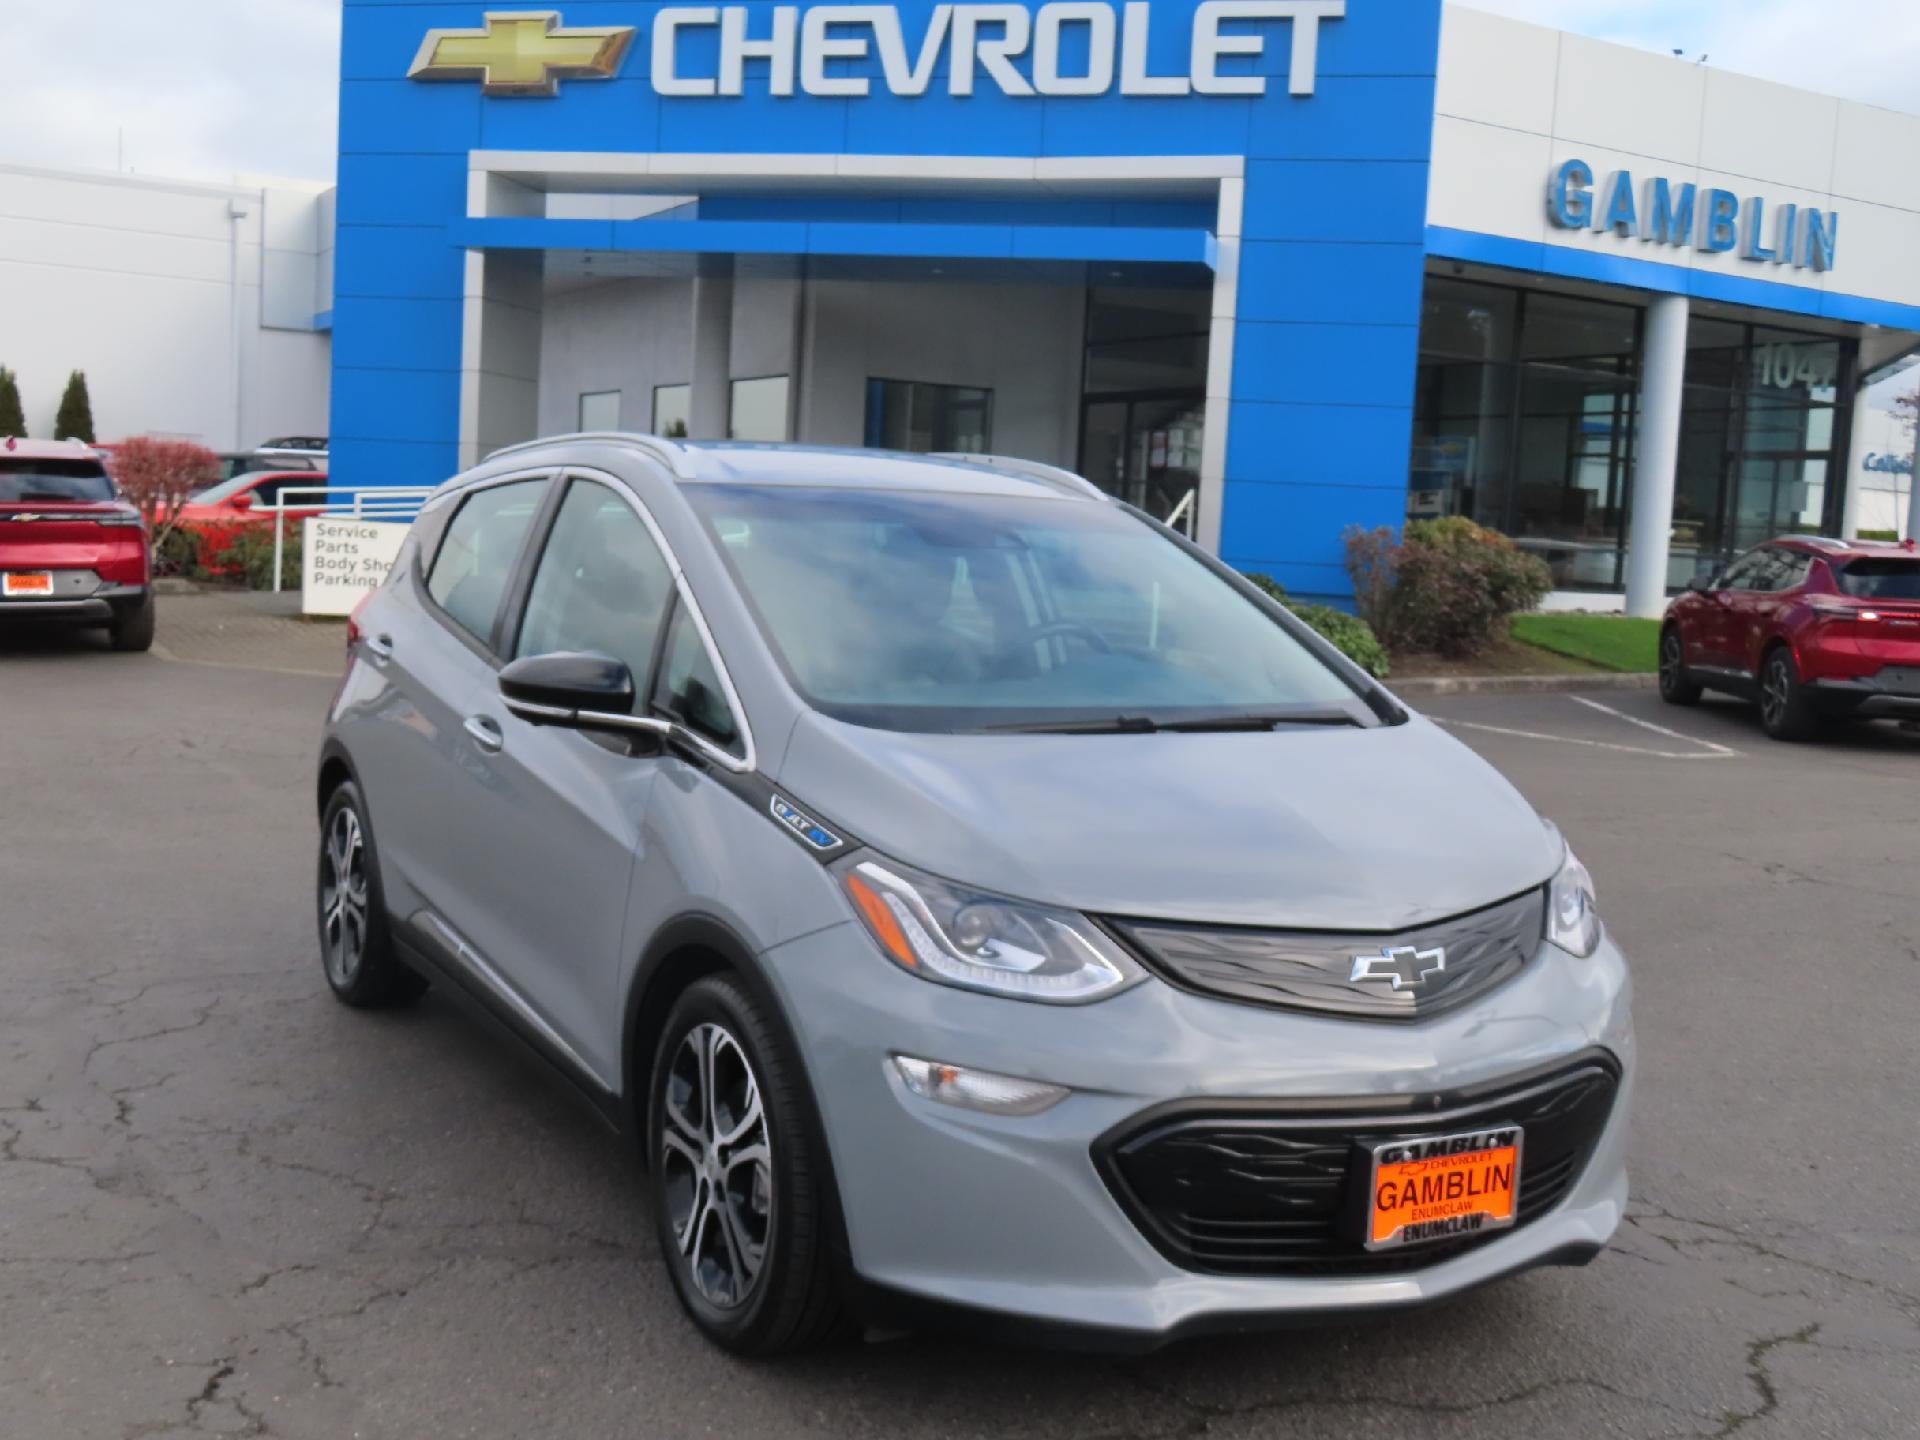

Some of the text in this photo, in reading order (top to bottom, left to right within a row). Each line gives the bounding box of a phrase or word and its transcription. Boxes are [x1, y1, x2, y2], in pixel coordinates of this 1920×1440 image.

[650, 0, 1346, 97] CHEVROLET
[1546, 158, 1839, 272] GAMBLIN
[316, 523, 378, 538] Service
[315, 539, 359, 553] Parts
[314, 556, 394, 573] Body Sho
[314, 571, 378, 590] Parking
[1430, 1152, 1493, 1169] CHEVROLET
[1376, 1163, 1510, 1211] GAMBLIN
[1411, 1200, 1473, 1221] ENUMCLAW
